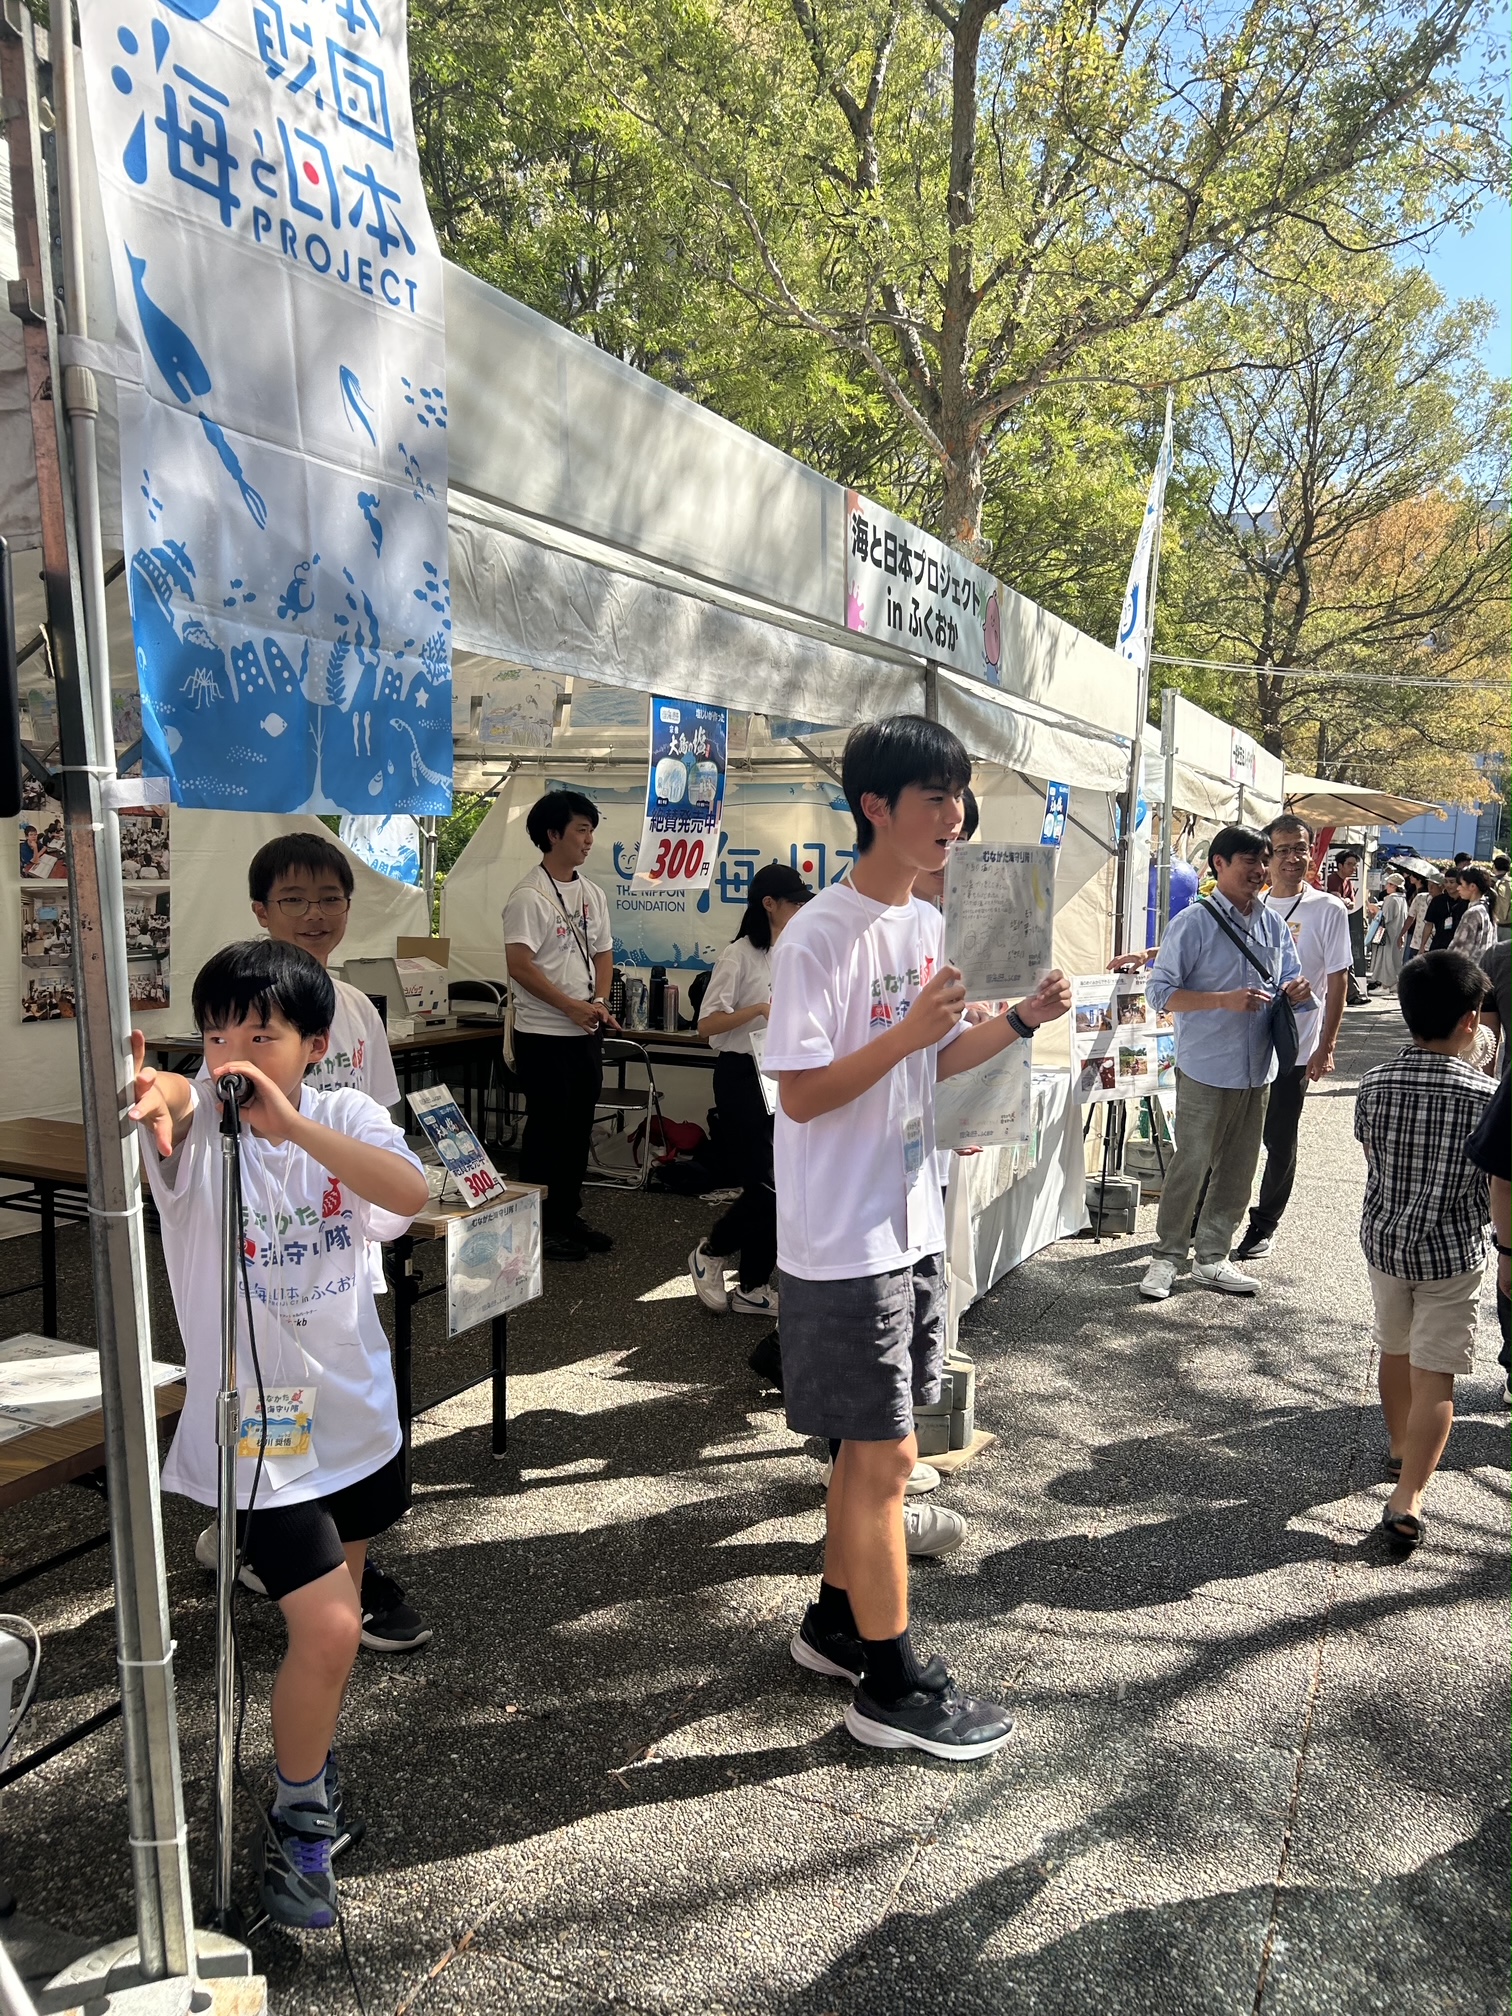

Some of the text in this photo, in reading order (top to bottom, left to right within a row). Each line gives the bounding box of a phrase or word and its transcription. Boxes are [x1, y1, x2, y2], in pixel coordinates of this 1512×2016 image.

[111, 18, 417, 258] 海と日本
[252, 206, 417, 312] PROJECT
[851, 512, 981, 617] 海と日本プロジェクト
[886, 585, 959, 652] in ふくおか
[649, 808, 717, 834] 絶賛発売中
[616, 900, 686, 913] FOUNDATION
[696, 831, 861, 914] 海日
